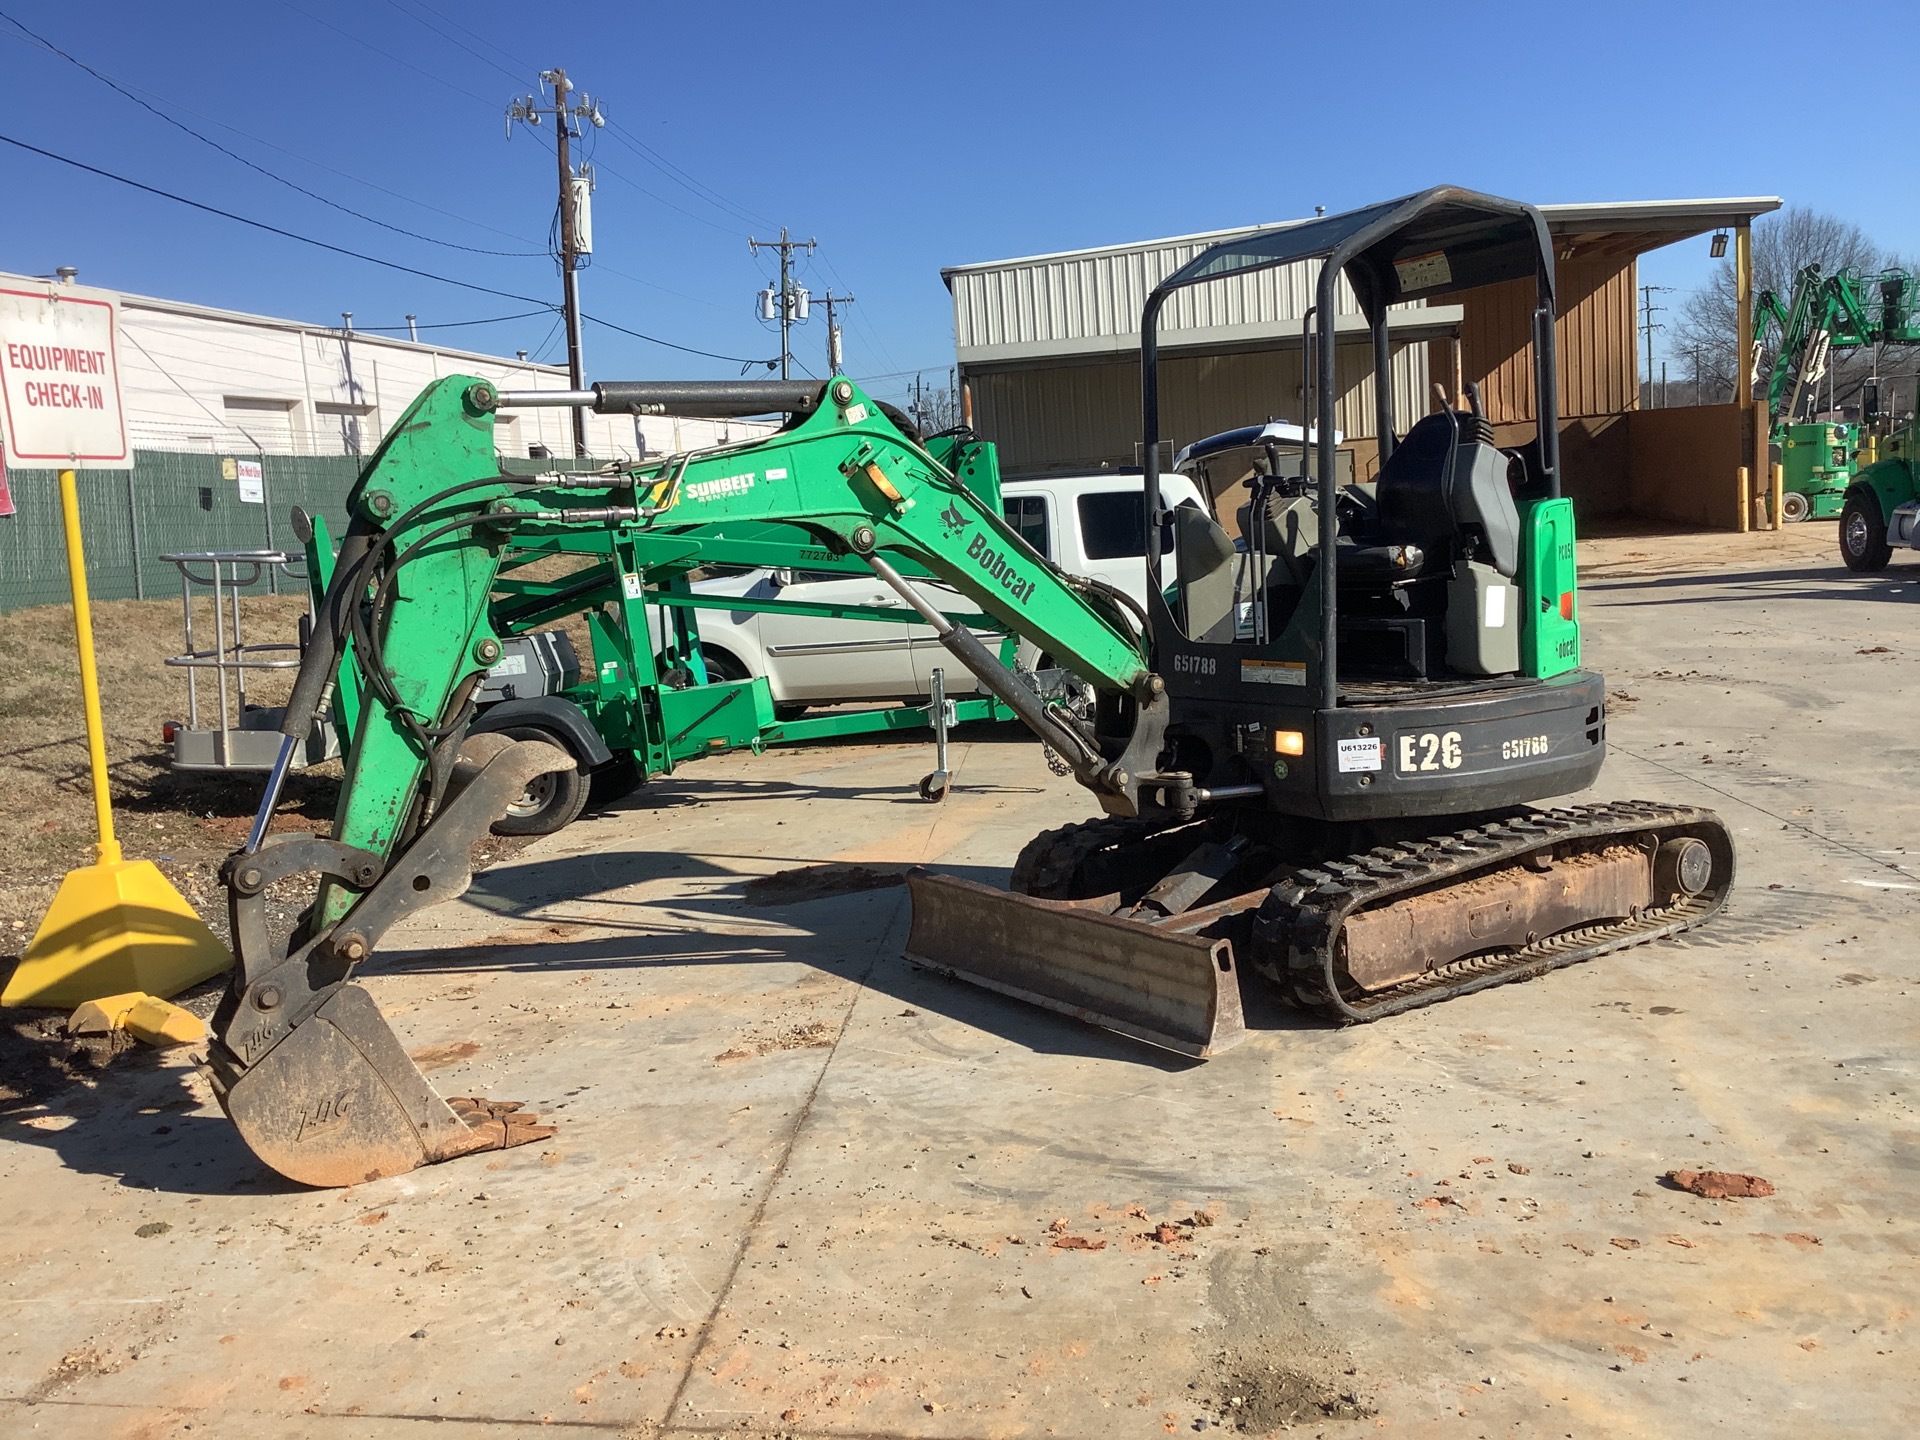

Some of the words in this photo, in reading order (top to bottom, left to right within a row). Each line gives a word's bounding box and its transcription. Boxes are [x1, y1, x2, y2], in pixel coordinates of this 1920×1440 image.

[8, 343, 106, 375] EQUIPMENT
[25, 381, 104, 410] CHECK-IN
[685, 472, 756, 499] SUNBELT
[697, 488, 749, 503] RENTALS
[800, 549, 840, 562] 772703
[965, 532, 1036, 606] Bobcat
[1174, 654, 1217, 675] 651788
[1340, 743, 1378, 752] U613226
[1399, 731, 1462, 772] E26
[1502, 735, 1549, 760] 651788
